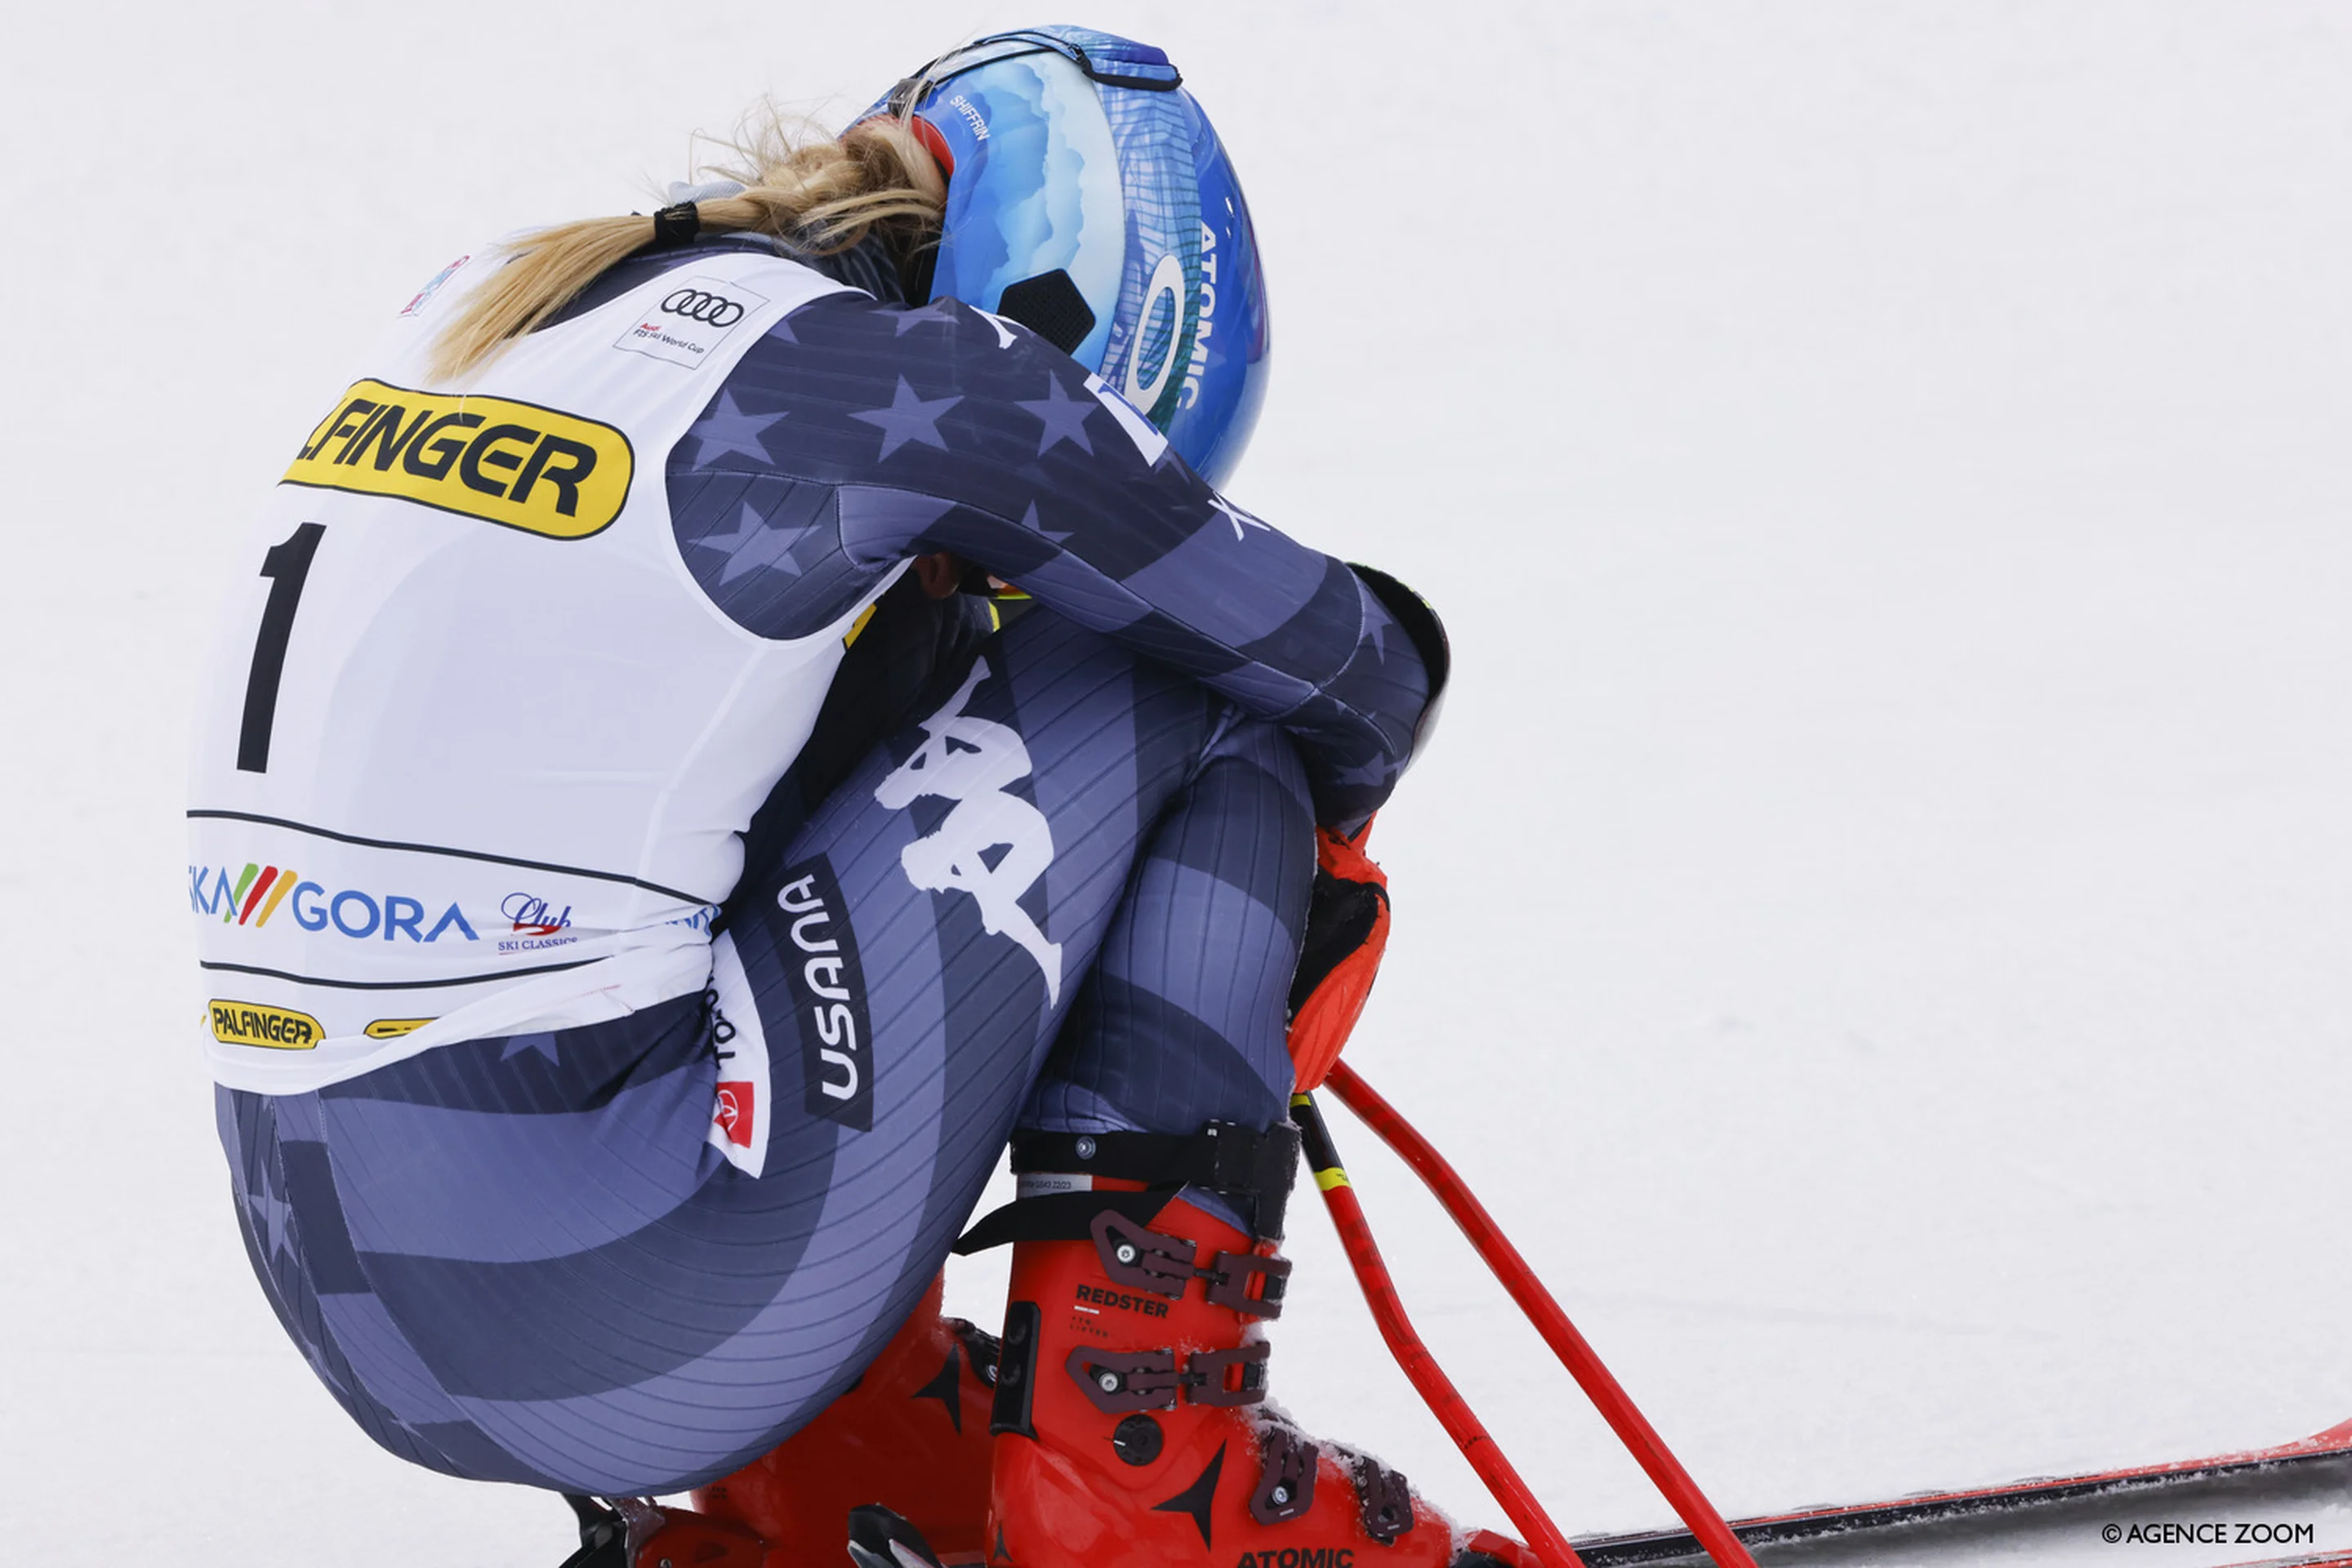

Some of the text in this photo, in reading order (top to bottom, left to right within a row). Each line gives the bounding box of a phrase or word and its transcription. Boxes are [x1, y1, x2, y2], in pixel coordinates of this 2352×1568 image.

[950, 95, 991, 140] SHIFFRIN
[1176, 220, 1217, 410] ATOMIC
[662, 335, 688, 349] World
[687, 343, 705, 354] Cup
[237, 522, 327, 773] 1
[292, 880, 480, 942] GORA
[497, 940, 519, 951] SKI
[777, 873, 859, 1101] USANA
[212, 1008, 312, 1044] PALFINGER
[1076, 1283, 1169, 1319] REDSTER
[1236, 1547, 1354, 1568] ATOMIC
